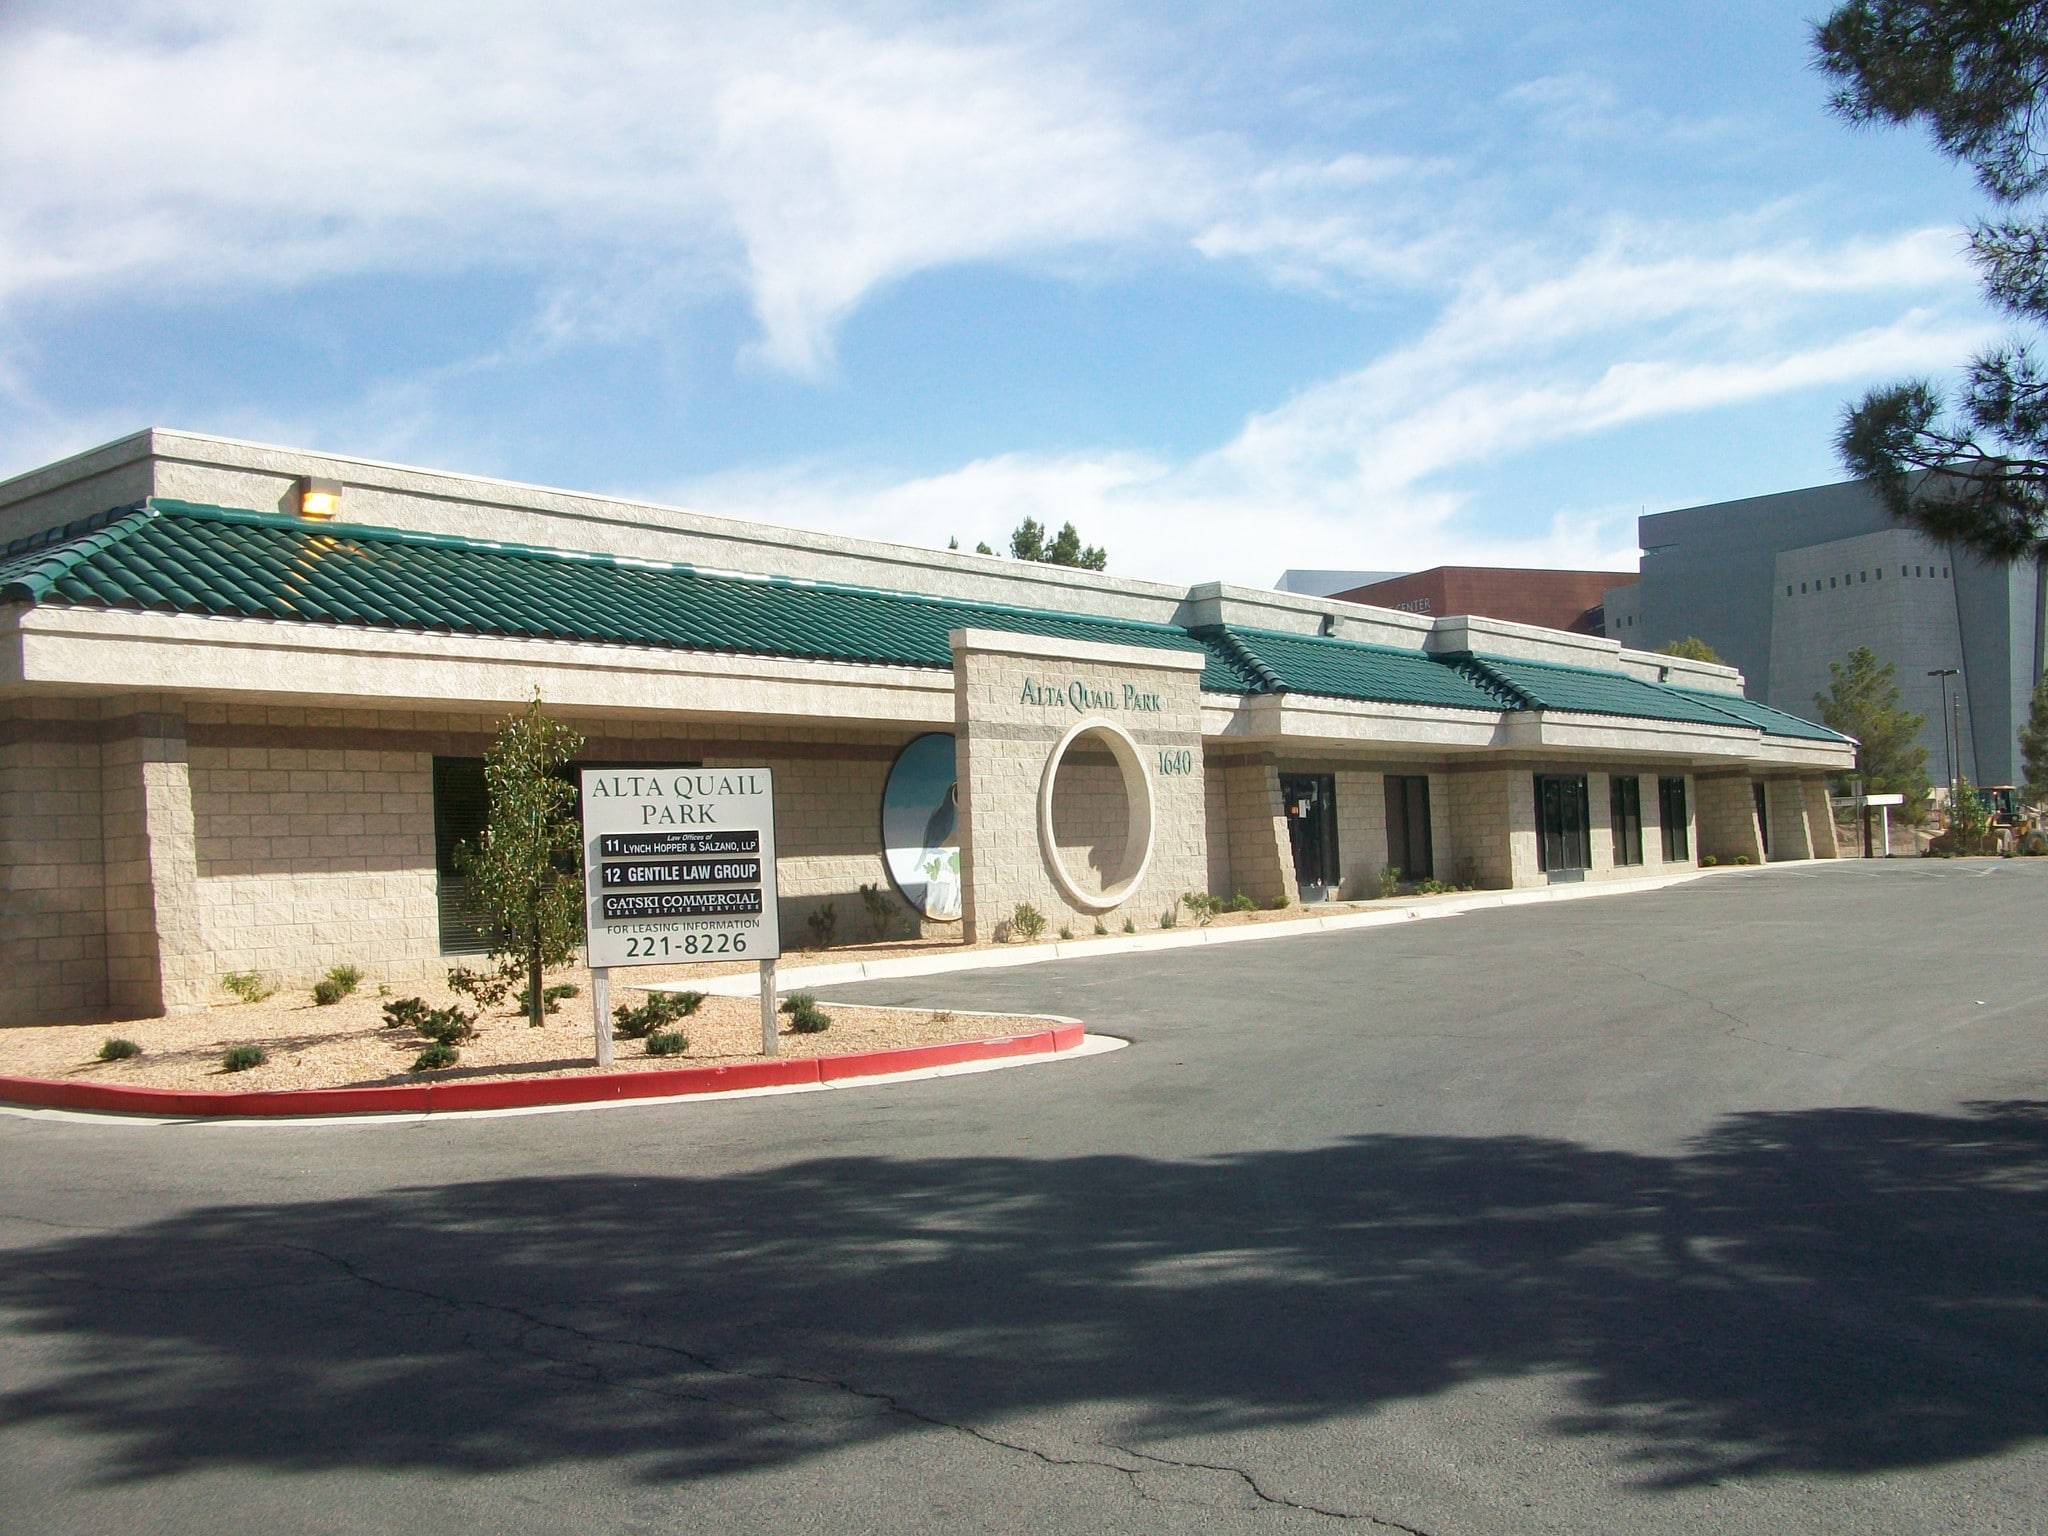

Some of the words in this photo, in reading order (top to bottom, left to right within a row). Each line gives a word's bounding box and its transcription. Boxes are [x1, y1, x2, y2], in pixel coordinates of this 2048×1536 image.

[1158, 750, 1191, 775] 1640
[592, 777, 664, 797] ALTA
[674, 775, 763, 799] QUAIL
[641, 804, 716, 825] PARK
[605, 839, 619, 851] 11
[623, 844, 651, 853] LYNCH
[654, 843, 687, 852] HOPPER
[690, 843, 696, 851] &
[699, 841, 739, 852] SALZANO,
[741, 841, 756, 850] LLP
[605, 868, 621, 882] 12
[628, 866, 680, 882] GENTILE
[683, 866, 711, 880] LAW
[714, 864, 757, 879] GROUP
[606, 897, 658, 909] GATSKI
[661, 893, 759, 907] COMMERCIAL
[607, 925, 629, 934] FOR
[632, 922, 679, 933] LEASING
[683, 919, 760, 931] INFORMATION
[626, 932, 747, 957] 221-8226
